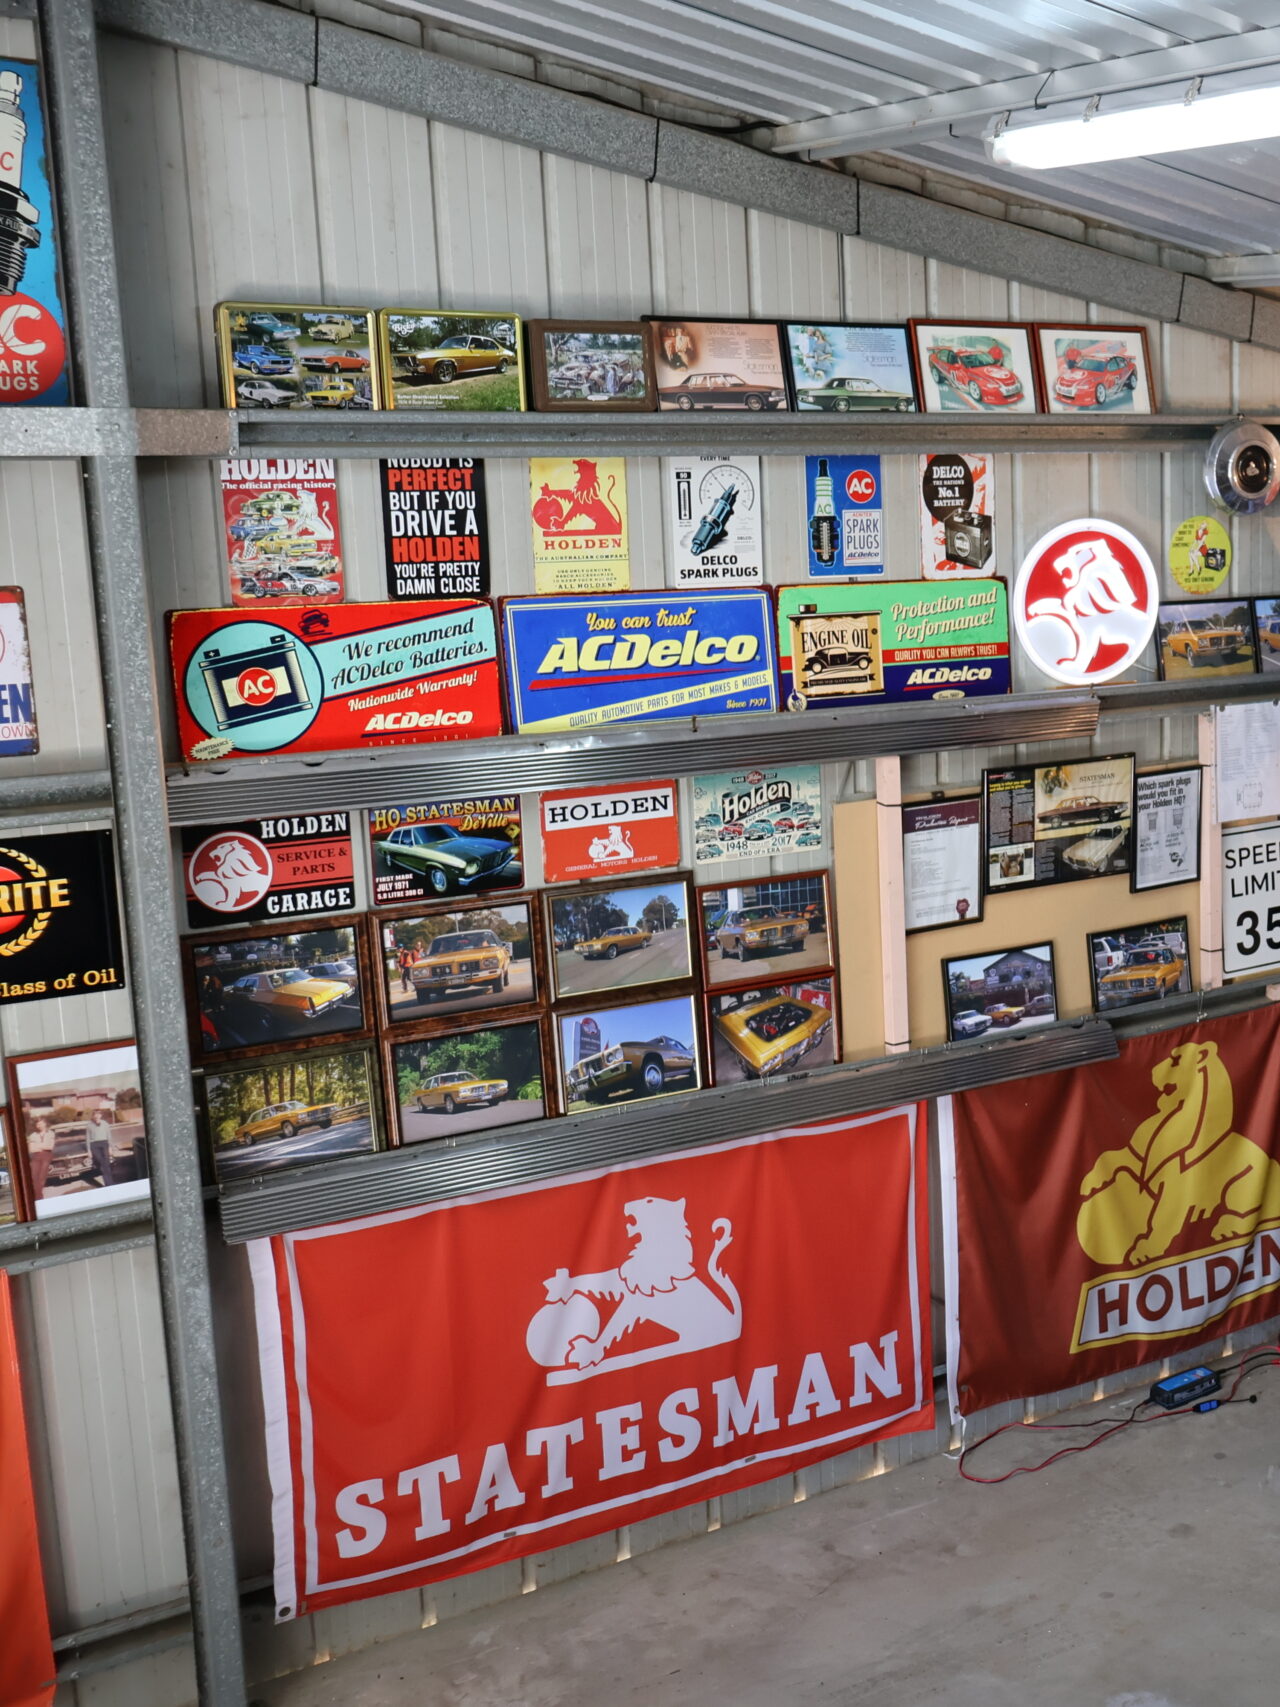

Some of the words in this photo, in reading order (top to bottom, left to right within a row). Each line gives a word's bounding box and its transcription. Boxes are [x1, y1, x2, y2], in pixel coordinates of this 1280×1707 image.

[0, 360, 40, 375] ARK
[0, 376, 40, 391] UGS
[388, 469, 474, 491] PERFECT
[932, 466, 964, 479] DELCO
[239, 481, 271, 490] official
[273, 481, 302, 491] racing
[849, 478, 873, 494] AC
[390, 492, 419, 511] BUT
[426, 492, 440, 510] IF
[445, 491, 476, 509] YOU
[816, 504, 832, 515] AC
[933, 499, 965, 507] BATTERY
[390, 511, 458, 536] DRIVE
[464, 510, 479, 535] A
[846, 518, 879, 534] SPARK
[392, 536, 480, 563] HOLDEN
[544, 538, 622, 550] HOLDEN
[846, 534, 879, 550] PLUGS
[701, 555, 738, 566] DELCO
[393, 564, 435, 579] YOU'RE
[439, 562, 480, 577] PRETTY
[680, 567, 719, 580] SPARK
[722, 566, 758, 577] PLUGS
[397, 578, 435, 595] DAMN
[440, 577, 481, 594] CLOSE
[890, 594, 965, 622] Protection
[967, 587, 997, 606] and
[586, 612, 616, 631] You
[622, 613, 651, 628] can
[656, 606, 697, 628] trust
[895, 609, 995, 643] Performance!
[342, 640, 373, 661] We
[377, 617, 475, 653] recommend
[801, 628, 849, 653] ENGINE
[851, 628, 872, 650] OIL
[537, 630, 758, 674] ACDelco
[894, 649, 921, 661] QUALITY
[921, 648, 935, 660] YOU
[936, 647, 950, 659] CAN
[950, 645, 975, 657] ALWAYS
[976, 644, 998, 656] TRUST!
[331, 660, 404, 690] ACDelco
[907, 666, 992, 685] ACDelco
[242, 676, 274, 699] AC
[348, 687, 415, 712] Nationwide
[416, 669, 478, 696] Warranty!
[569, 713, 598, 728] QUALITY
[601, 702, 644, 719] AUTOMOTIVE
[647, 696, 669, 709] PARTS
[671, 693, 685, 704] FOR
[688, 688, 706, 700] MOST
[709, 682, 732, 696] MAKES
[365, 709, 474, 731] ACDelco
[1079, 772, 1116, 783] STATESMAN
[1138, 782, 1157, 791] Which
[1158, 779, 1174, 789] spark
[1176, 777, 1191, 787] plugs
[722, 781, 791, 821] Holden
[1138, 791, 1156, 800] would
[1157, 790, 1168, 799] you
[1169, 788, 1177, 796] fit
[406, 797, 515, 823] STATESMAN
[549, 795, 670, 824] HOLDEN
[1152, 799, 1172, 809] Holden
[260, 813, 348, 840] HOLDEN
[726, 841, 748, 852] 1948
[772, 835, 792, 847] 2017
[277, 848, 336, 864] SERVICE
[565, 862, 598, 872] GENERAL
[600, 859, 628, 868] MOTORS
[631, 855, 658, 864] HOLDEN
[292, 862, 336, 876] PARTS
[377, 882, 393, 892] JULY
[394, 881, 409, 890] 1971
[0, 878, 70, 914] RITE
[267, 887, 350, 915] GARAGE
[0, 981, 46, 998] lass
[54, 973, 76, 990] of
[83, 968, 117, 986] Oil
[334, 1329, 903, 1559] STATESMAN
